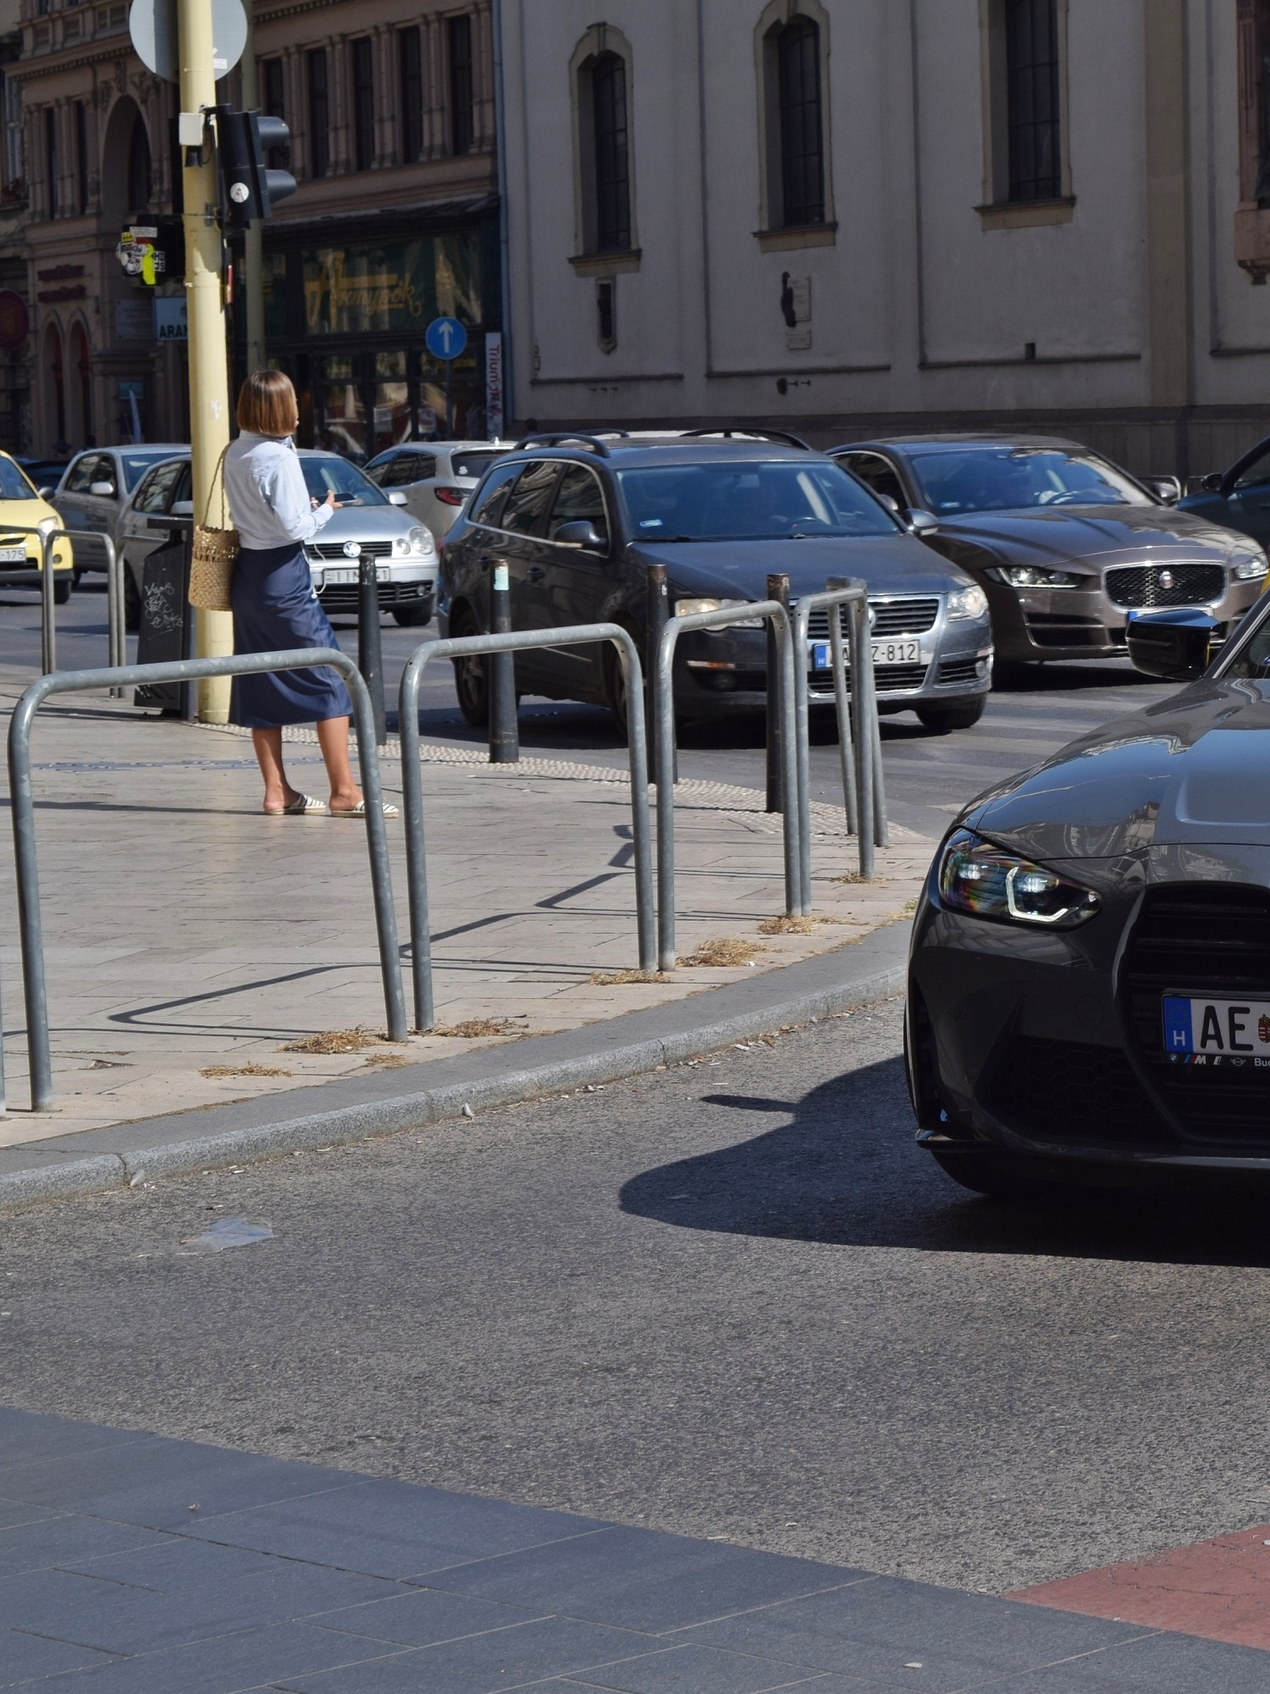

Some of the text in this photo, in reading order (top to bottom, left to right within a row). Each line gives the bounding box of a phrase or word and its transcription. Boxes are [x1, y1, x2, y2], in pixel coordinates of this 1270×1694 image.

[870, 644, 916, 662] Z-812
[1200, 1005, 1255, 1052] AE
[1173, 1030, 1186, 1046] H
